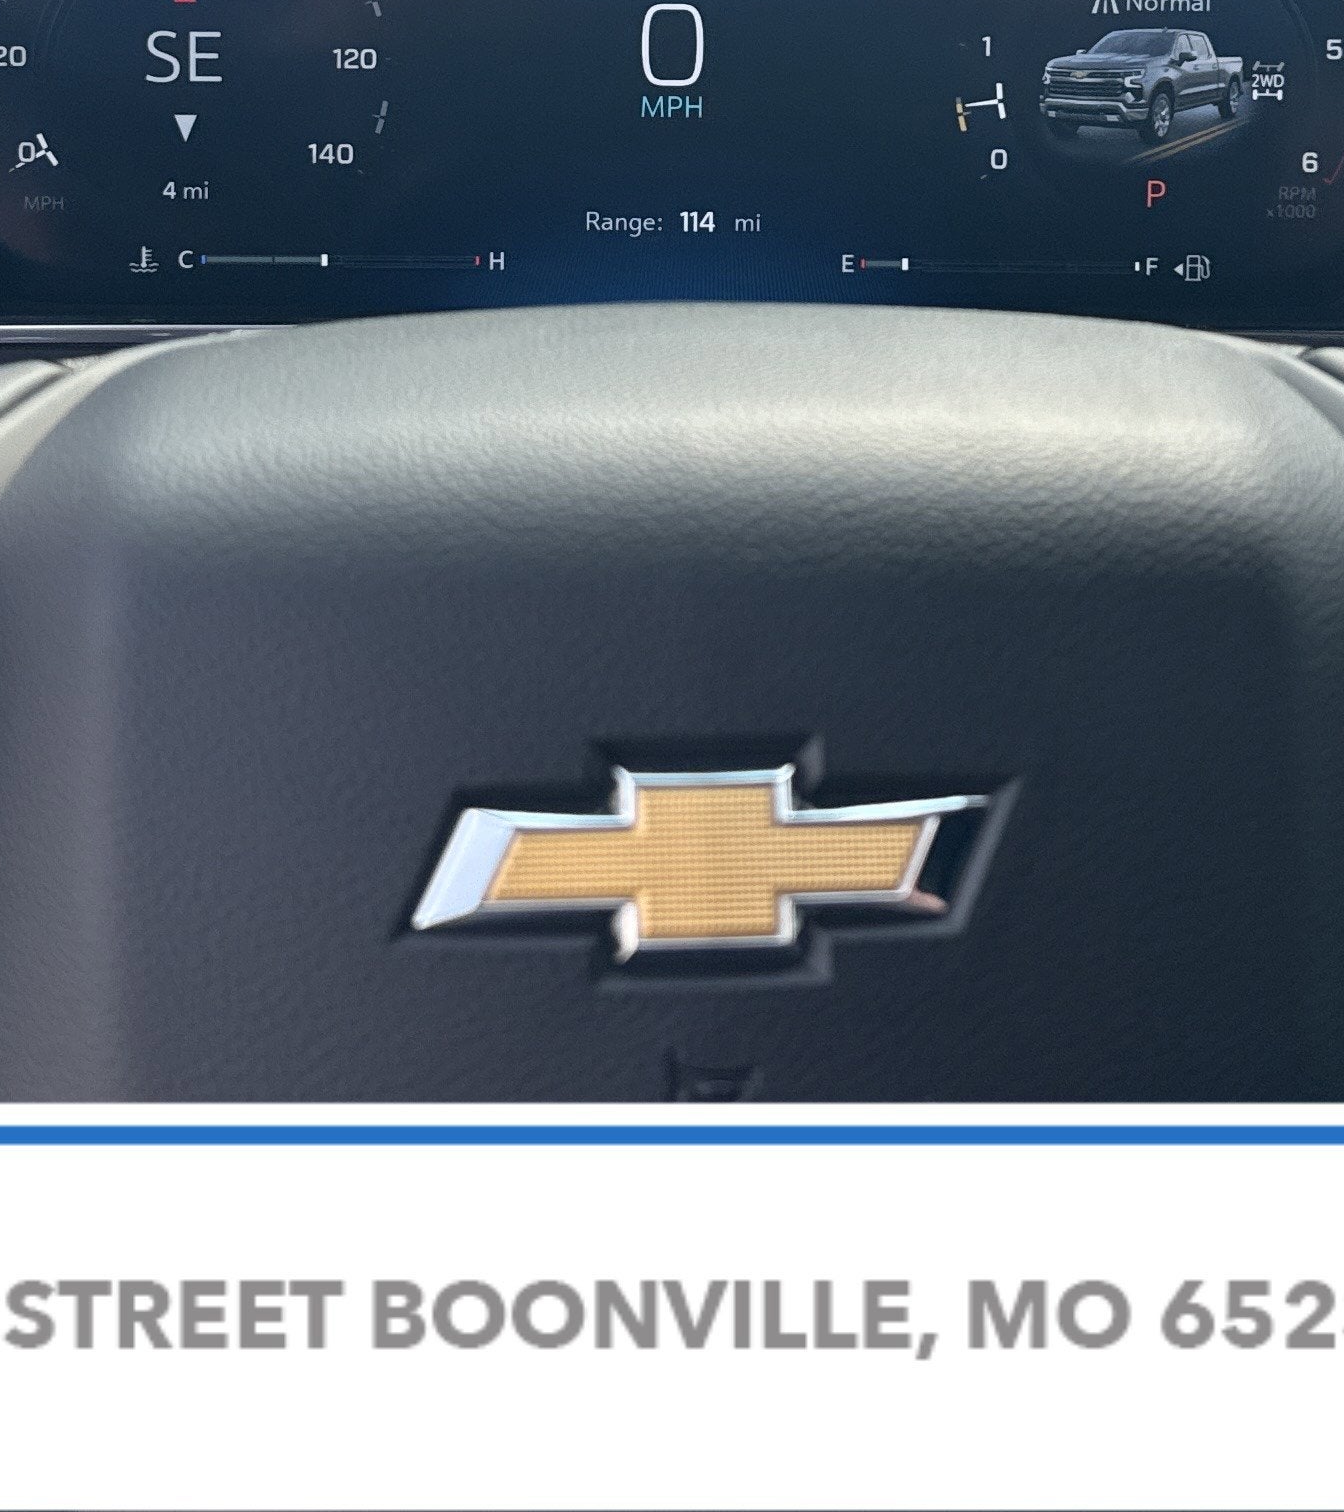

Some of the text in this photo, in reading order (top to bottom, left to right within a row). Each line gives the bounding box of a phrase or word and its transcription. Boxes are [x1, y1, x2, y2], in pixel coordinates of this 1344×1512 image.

[640, 2, 705, 88] 0
[981, 36, 992, 57] 1
[1326, 38, 1344, 61] 5
[144, 29, 224, 85] SE
[332, 47, 378, 71] 120
[1251, 73, 1285, 89] 2WD
[640, 95, 704, 120] MPH
[307, 142, 355, 167] 140
[990, 148, 1008, 171] 0
[1302, 151, 1319, 173] 6
[162, 181, 210, 201] 4 mi
[1147, 180, 1167, 209] P
[1278, 187, 1317, 201] RPM
[23, 195, 65, 213] MPH
[585, 209, 762, 238] Range: 114 mi
[177, 250, 506, 272] C H
[842, 255, 1159, 277] E F
